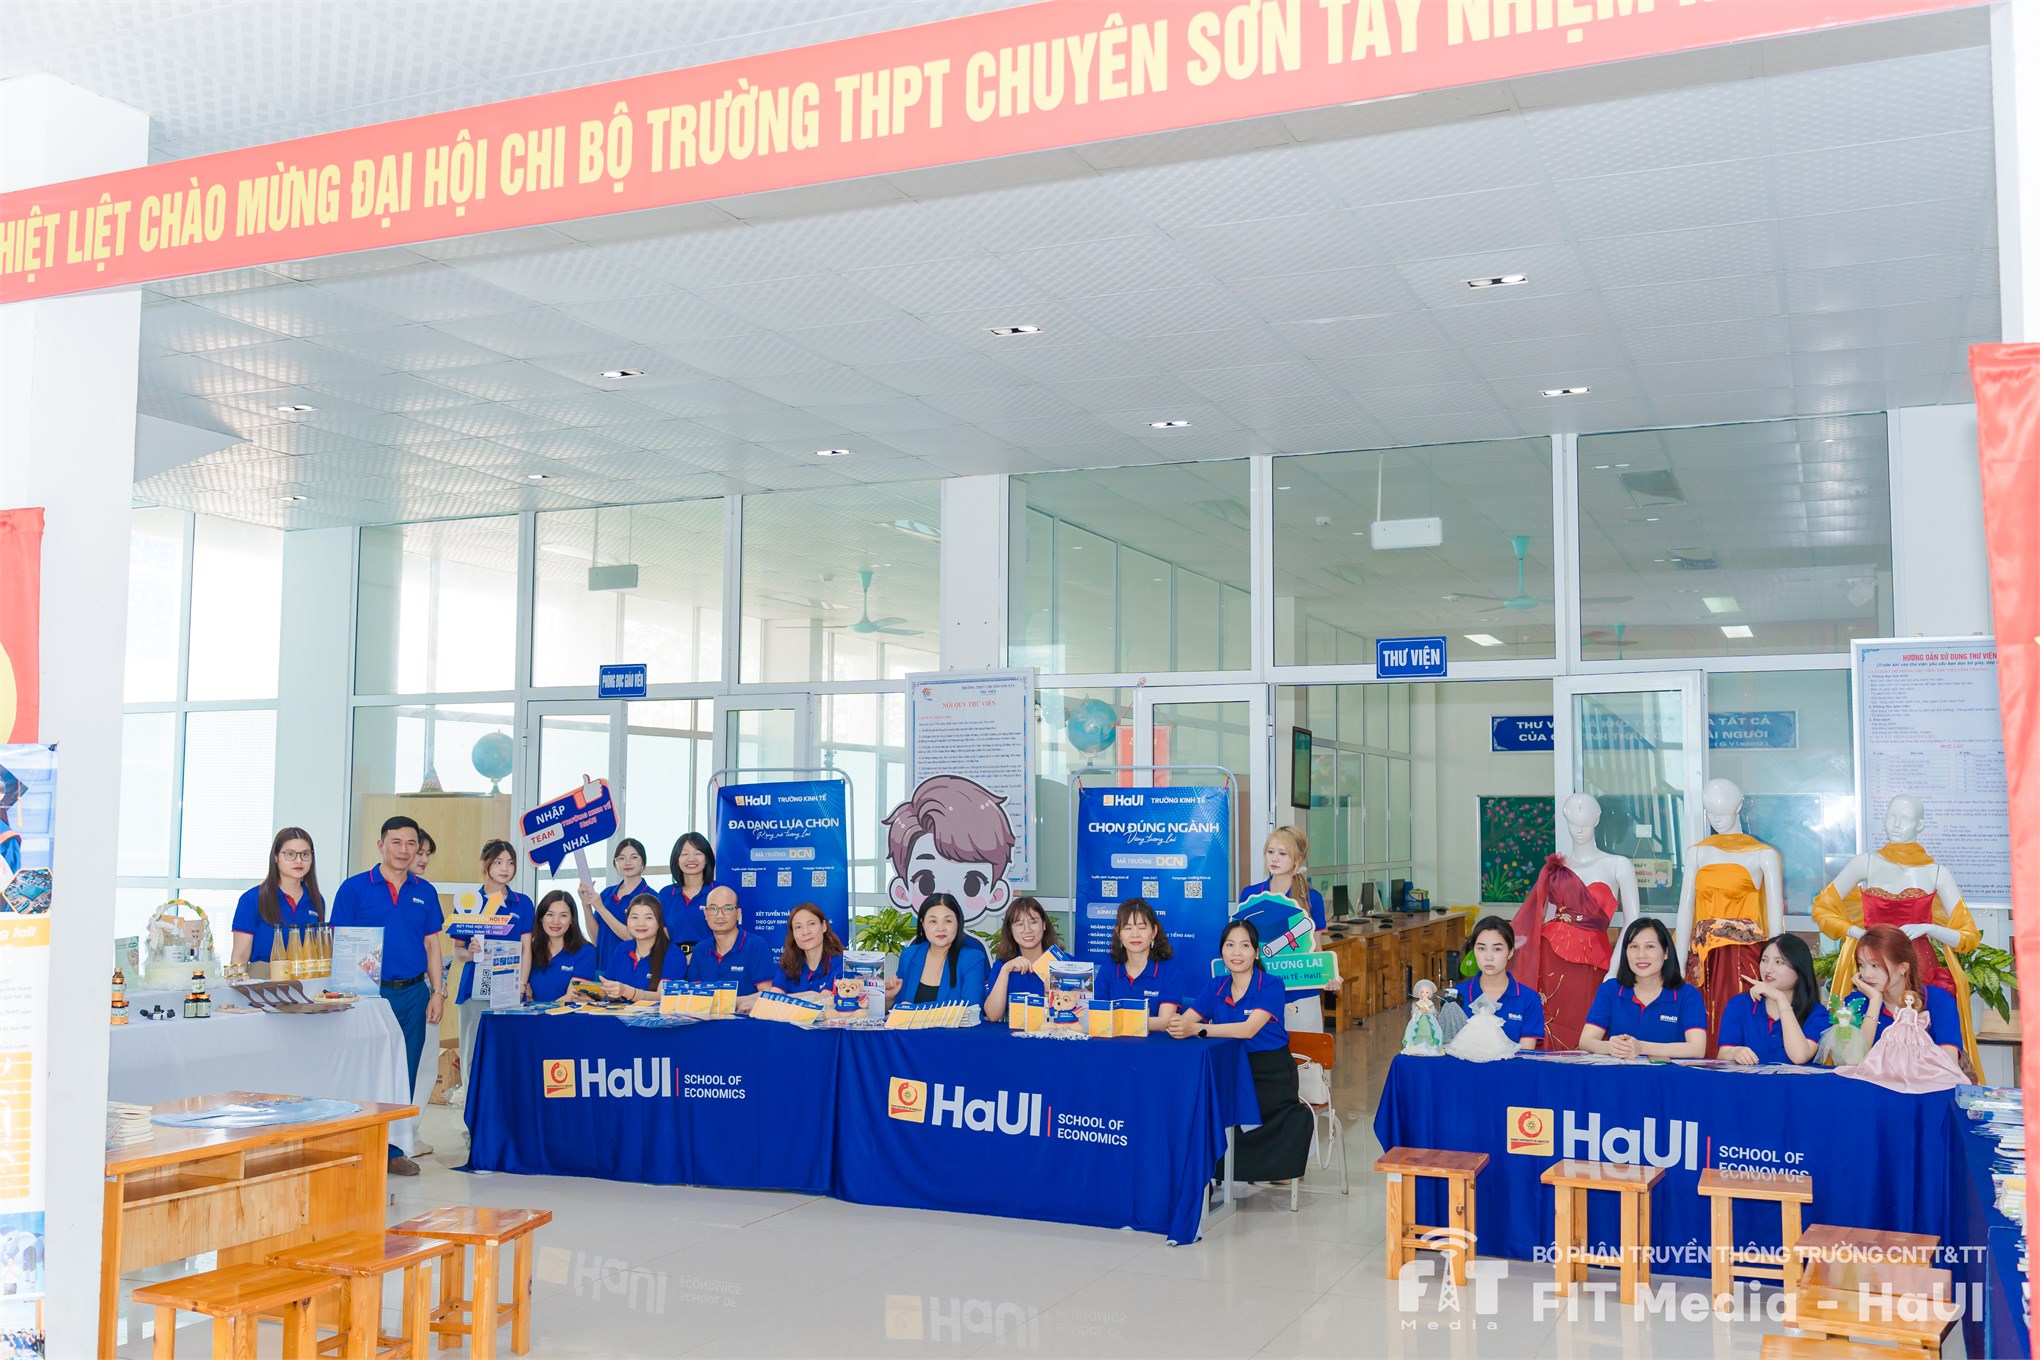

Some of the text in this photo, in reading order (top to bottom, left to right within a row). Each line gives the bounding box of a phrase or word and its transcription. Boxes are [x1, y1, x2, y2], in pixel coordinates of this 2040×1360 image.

[66, 192, 132, 272] LIỆT
[139, 177, 227, 252] CHÀO
[235, 161, 341, 237] MỪNG
[351, 152, 414, 228] ĐẠI
[423, 129, 488, 217] HỘI
[500, 125, 566, 196] CHI
[579, 101, 633, 194] BỘ
[646, 77, 820, 173] TRƯỜNG
[835, 58, 951, 143] THPT
[965, 12, 1168, 123] CHUYÊN
[1187, 0, 1301, 87] SƠN
[1383, 645, 1440, 669] THƯ VIỆN
[1516, 720, 1544, 730] THƯ
[1518, 731, 1547, 742] CỦA
[745, 794, 771, 806] HaUI
[778, 795, 802, 803] TRƯỜNG
[1115, 794, 1143, 806] HaUI
[1151, 796, 1179, 804] TRƯỜNG
[536, 805, 565, 825] NHẬP
[728, 817, 839, 831] ĐA DẠNG LỰA CHỌN
[1088, 820, 1220, 835] CHỌN ĐÚNG NGÀNH
[531, 829, 555, 845] TEAM
[562, 834, 590, 852] NHA!
[789, 849, 812, 858] DCN
[1156, 856, 1184, 866] DCN
[1265, 958, 1323, 971] TƯƠNG LAI
[580, 1057, 671, 1098] HaUI
[684, 1074, 742, 1085] SCHOOL OF
[684, 1087, 746, 1099] ECONOMICS
[932, 1083, 1042, 1137] HaUI
[1058, 1113, 1124, 1131] SCHOOL OF
[1057, 1127, 1128, 1146] ECONOMICS
[1563, 1109, 1698, 1171] HaUI
[1719, 1145, 1804, 1164] SCHOOL OF
